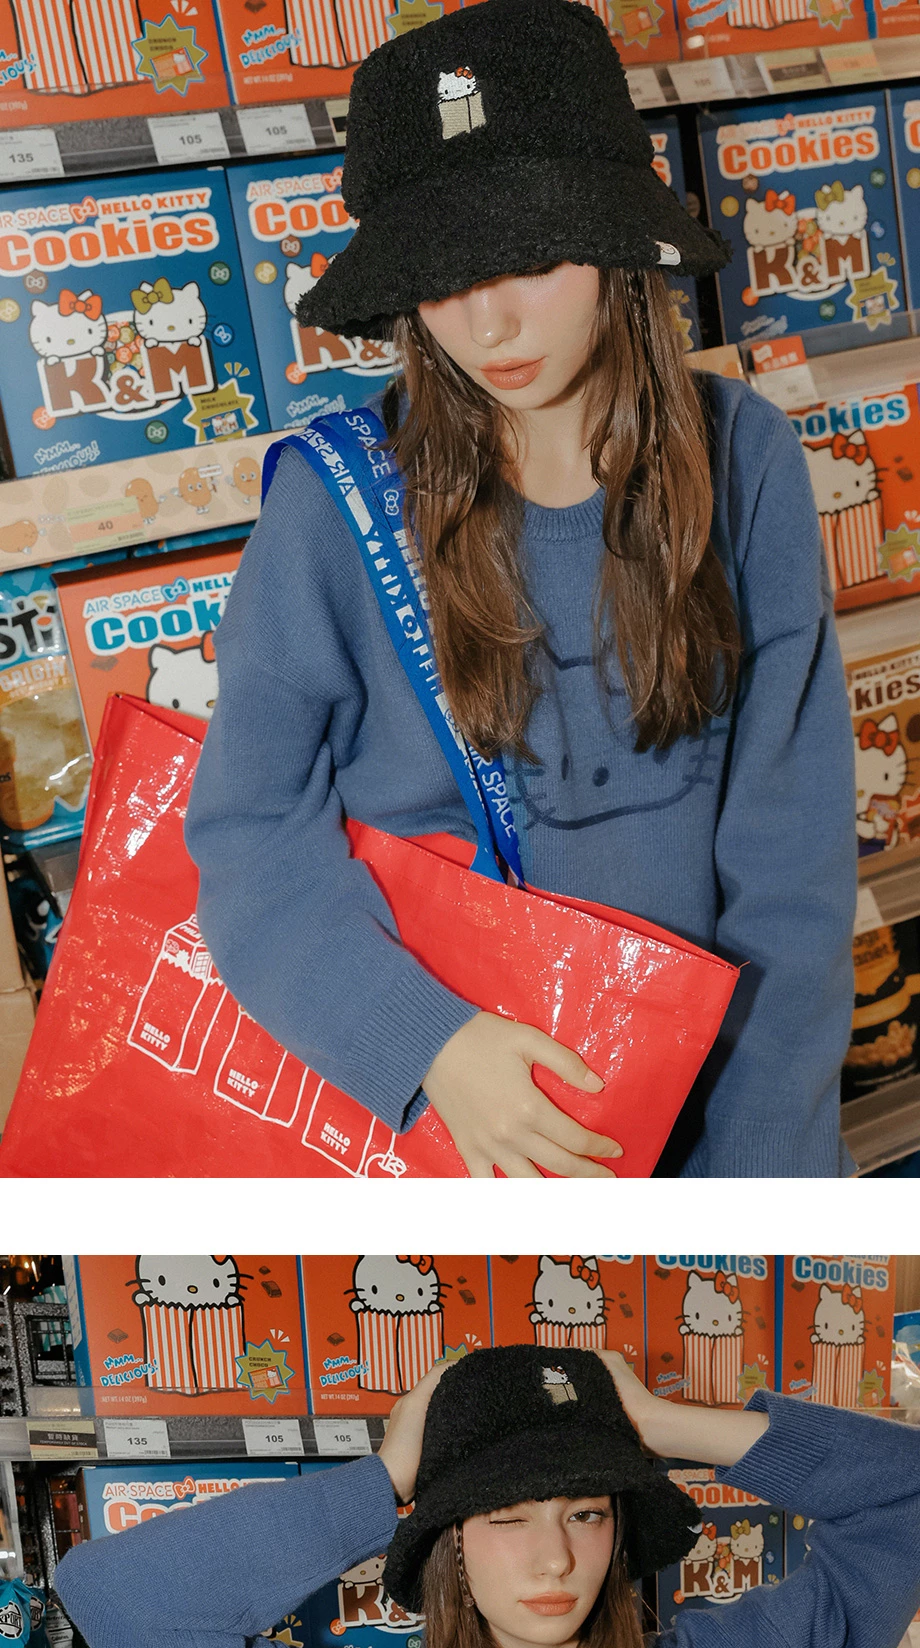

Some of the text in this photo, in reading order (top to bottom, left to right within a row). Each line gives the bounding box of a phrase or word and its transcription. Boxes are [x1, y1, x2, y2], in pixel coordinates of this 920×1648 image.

[180, 135, 203, 146] 105
[265, 126, 287, 137] 105
[9, 153, 34, 164] 135
[722, 130, 876, 176] Cookies
[249, 176, 320, 197] AIR SPACE
[18, 192, 207, 226] SPACE HELLO KITTY
[254, 199, 349, 236] Coo
[0, 218, 214, 272] Cookies
[44, 342, 208, 412] K&M
[98, 520, 114, 531] 40
[85, 576, 235, 616] AIR SPACE HELL
[482, 770, 517, 839] SPACE
[140, 1030, 169, 1051] KITTY
[143, 1022, 171, 1044] HELLO
[226, 1077, 256, 1098] KITTY
[228, 1068, 259, 1090] HELLO
[319, 1131, 349, 1155] KITTY
[323, 1122, 351, 1147] HELLO
[794, 1256, 889, 1289] Cookies
[100, 1359, 160, 1388] DELICIOUS!
[319, 1361, 370, 1387] DELICIOUS!
[127, 1437, 148, 1445] 135
[265, 1435, 284, 1443] 105
[334, 1434, 352, 1442] 105
[105, 1483, 126, 1497] AIR
[130, 1483, 173, 1498] SPACE
[683, 1560, 759, 1594] K&M
